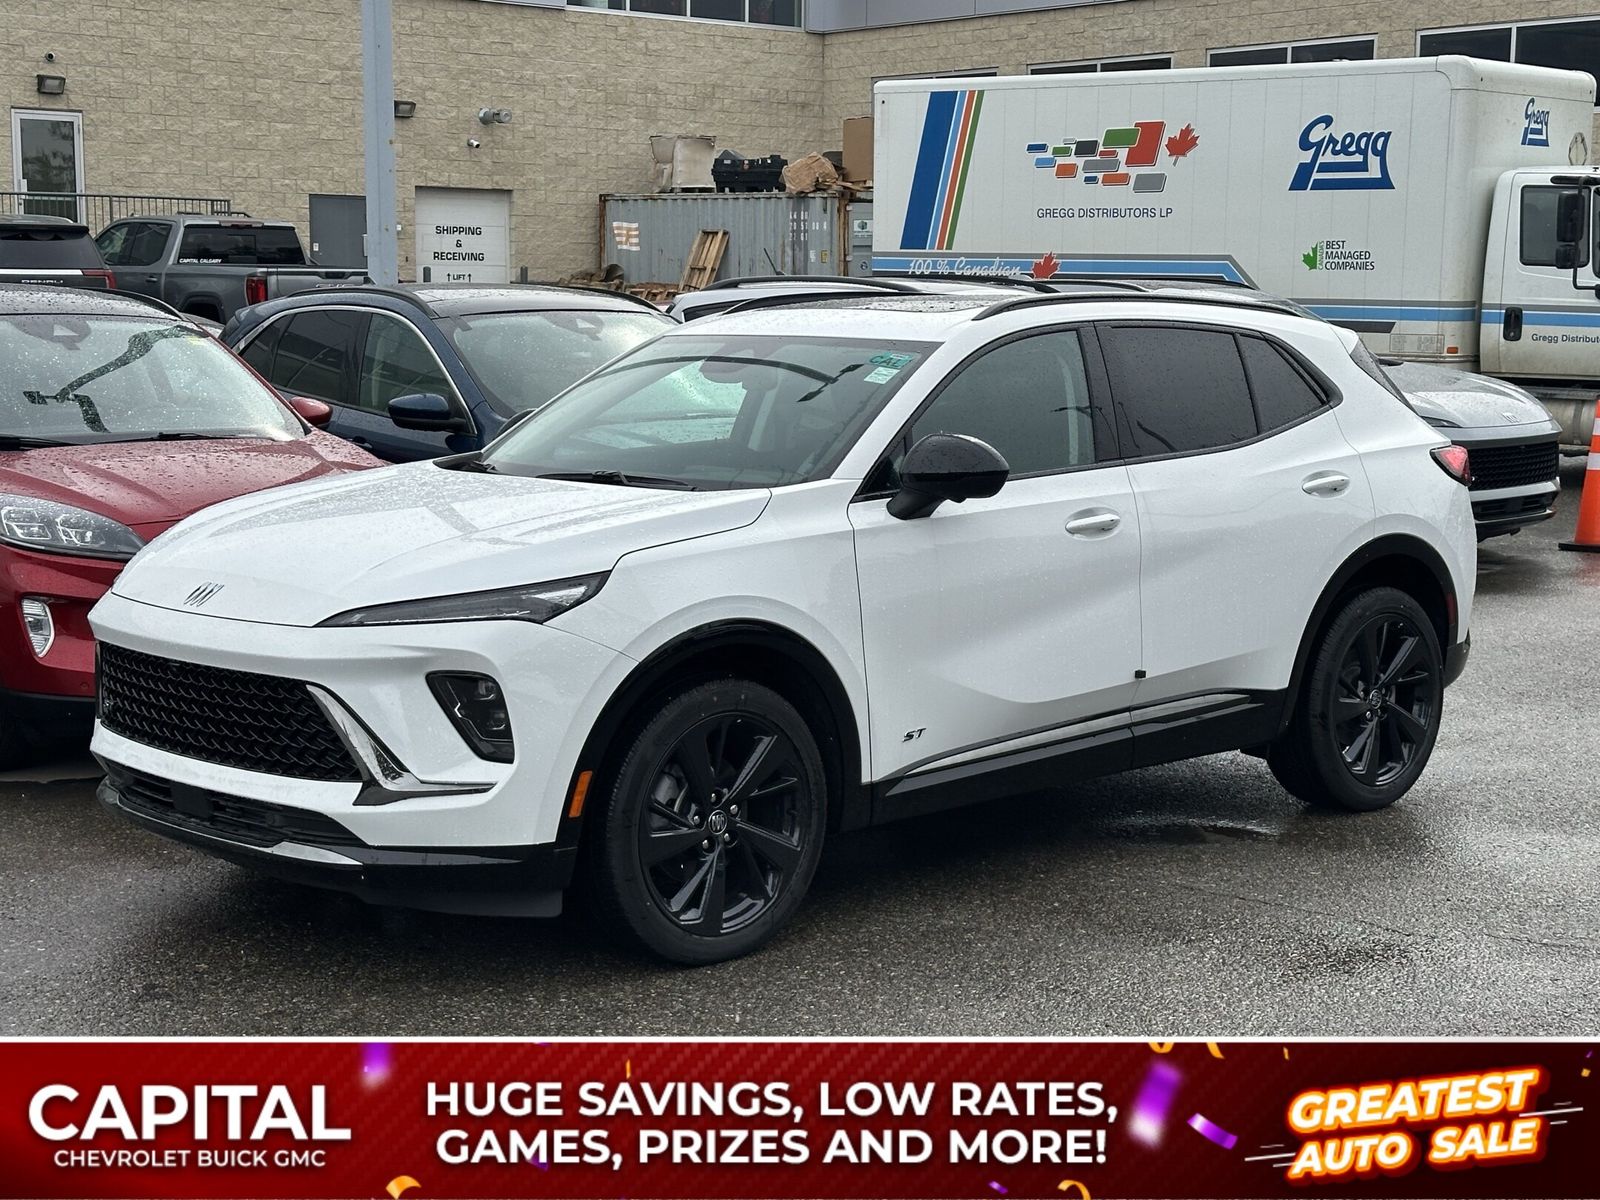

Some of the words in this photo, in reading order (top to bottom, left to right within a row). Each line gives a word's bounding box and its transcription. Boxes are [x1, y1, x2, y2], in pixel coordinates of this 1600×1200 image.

[1288, 114, 1396, 191] Gregg
[1037, 208, 1075, 219] GREGG
[1078, 207, 1157, 218] DISTRIBUTORS
[1159, 207, 1173, 218] LP
[435, 226, 482, 235] SHIPPING
[455, 239, 463, 248] &
[1325, 240, 1346, 250] BEST
[433, 252, 485, 261] RECEIVING
[1325, 250, 1371, 260] MANAGED
[909, 259, 932, 275] 100
[936, 259, 949, 275] %
[954, 256, 1020, 276] Canadian
[1324, 261, 1375, 271] COMPANIES
[1531, 333, 1558, 343] Gregg
[902, 727, 927, 742] ST
